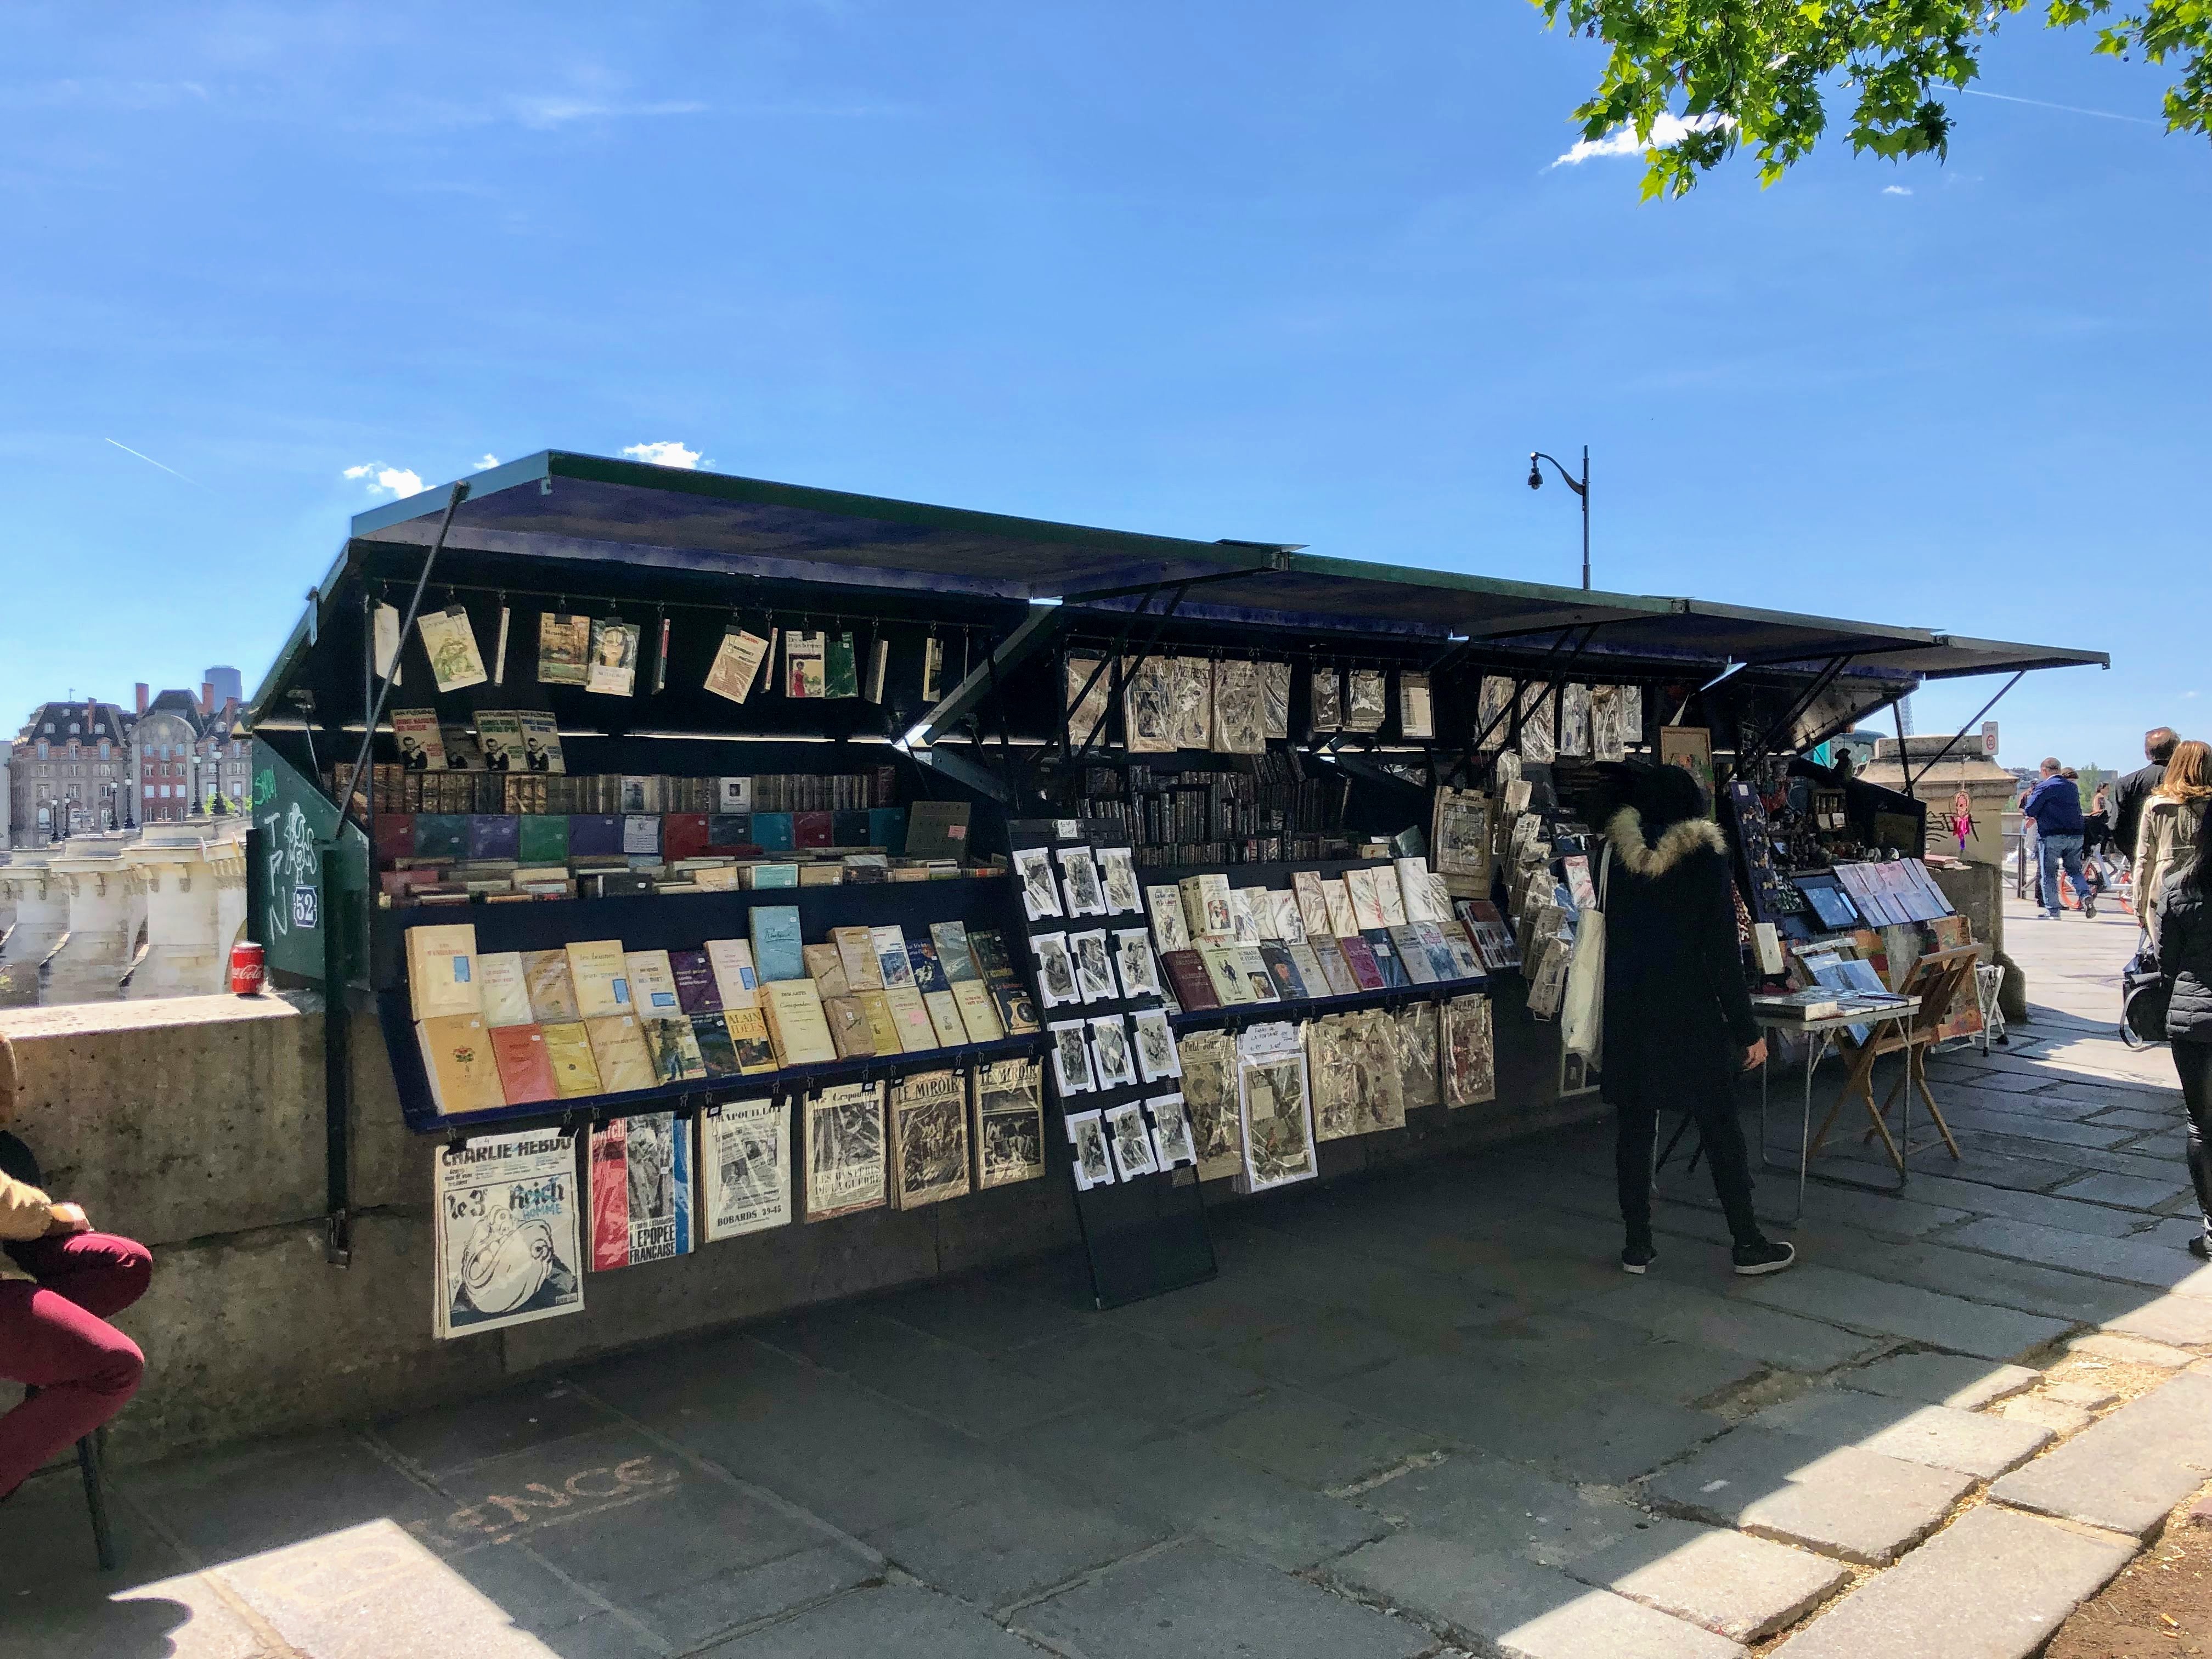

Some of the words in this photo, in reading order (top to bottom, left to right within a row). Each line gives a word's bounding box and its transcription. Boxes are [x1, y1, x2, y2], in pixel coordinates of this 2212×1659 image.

[296, 894, 314, 921] 52
[729, 1012, 761, 1024] ALAIN
[896, 1087, 909, 1101] LE
[916, 1077, 959, 1097] MIROIR
[712, 1107, 781, 1122] RAPOUILLOT
[447, 1194, 467, 1220] le
[717, 1210, 757, 1227] BOBARDS
